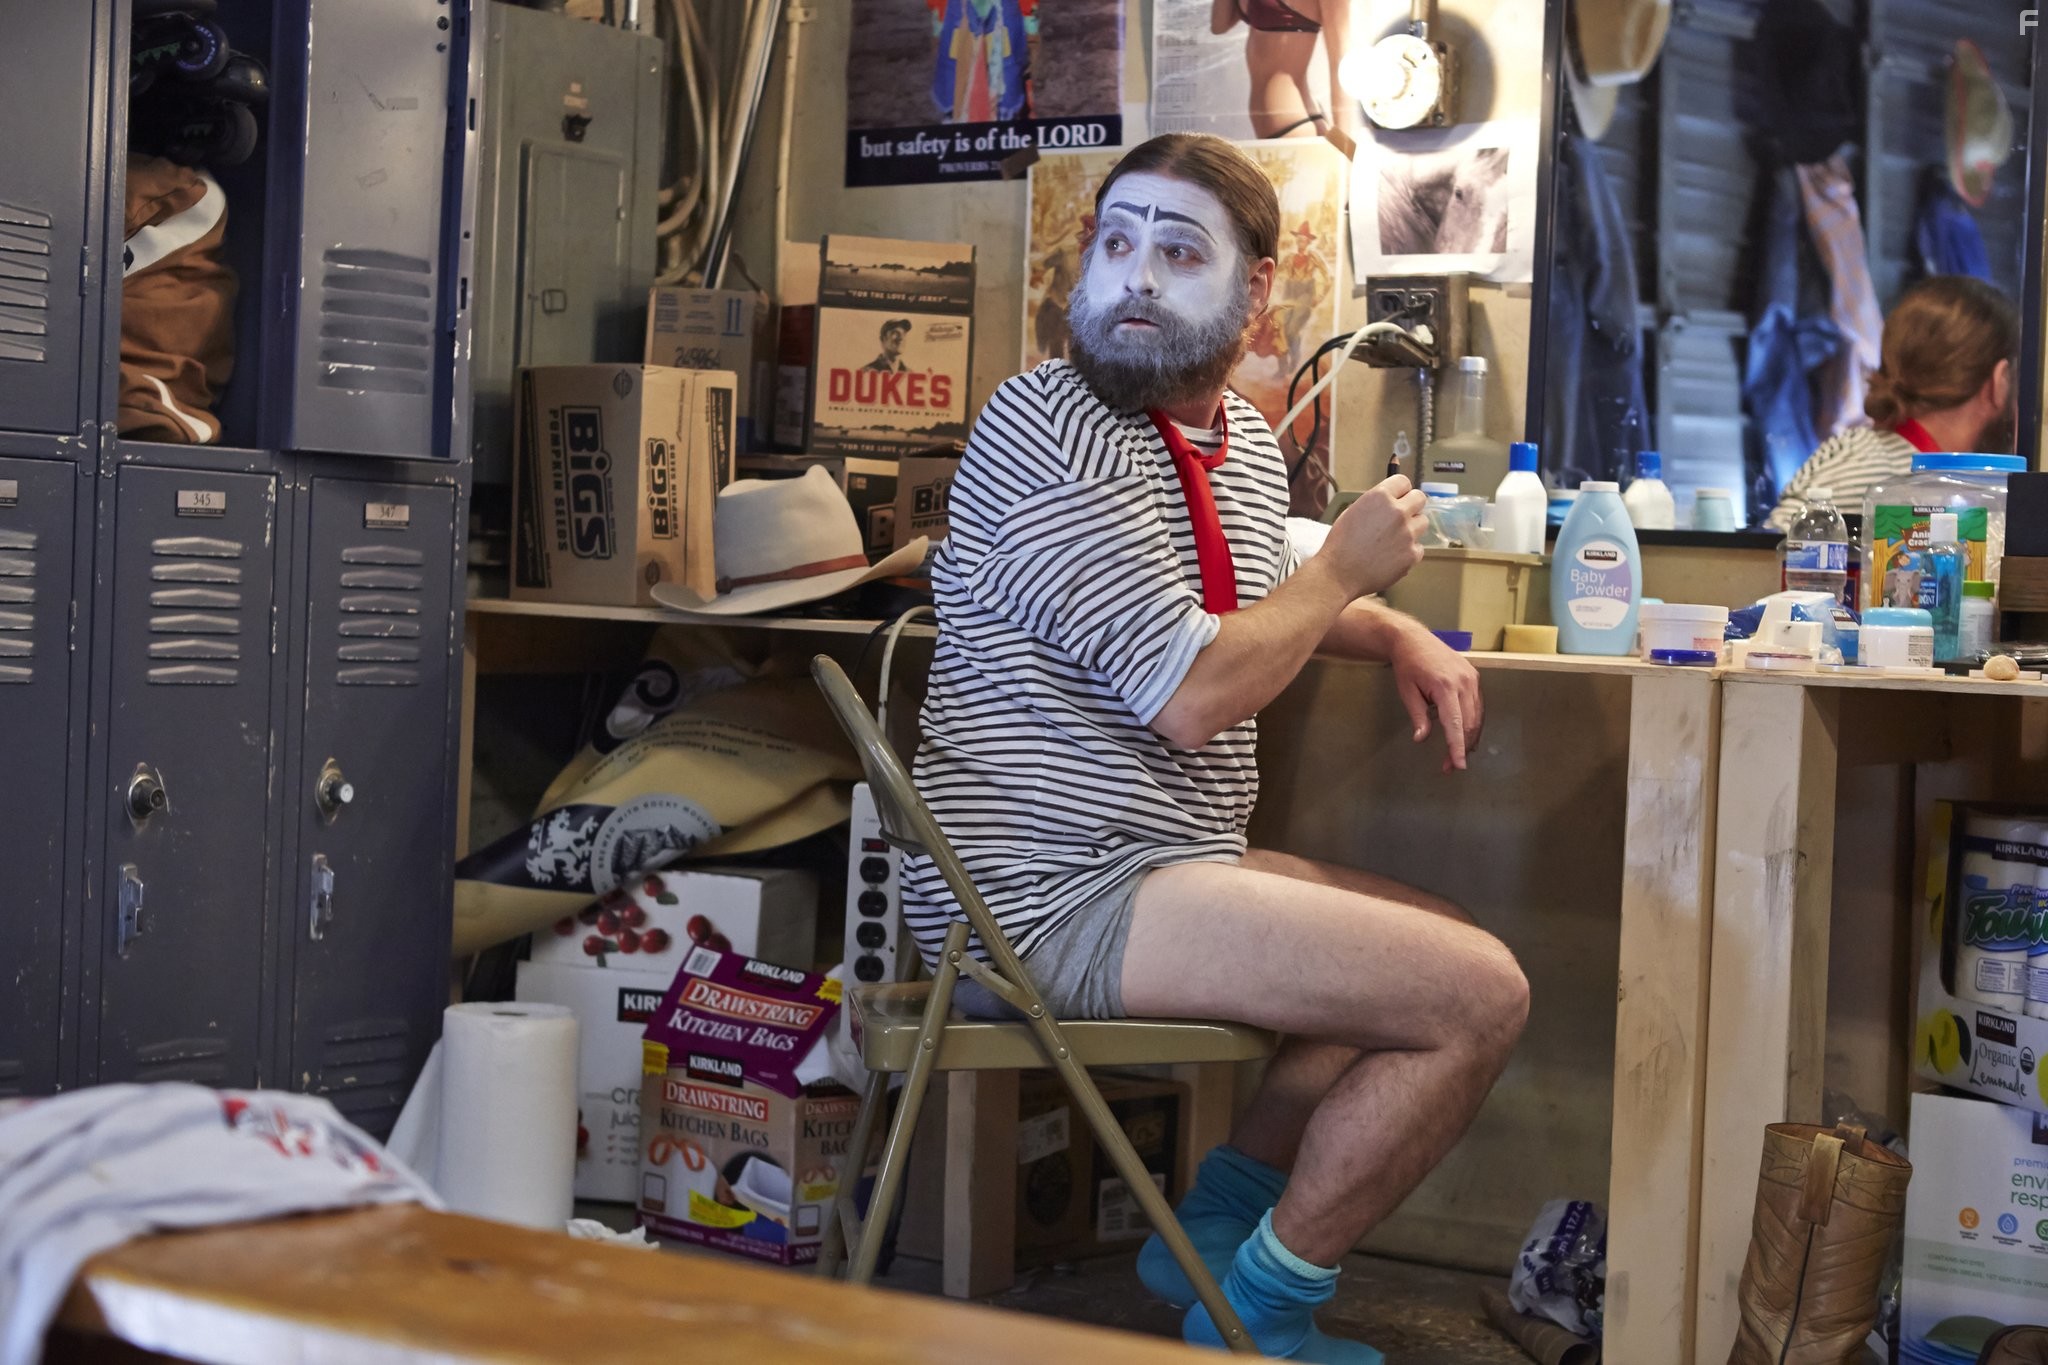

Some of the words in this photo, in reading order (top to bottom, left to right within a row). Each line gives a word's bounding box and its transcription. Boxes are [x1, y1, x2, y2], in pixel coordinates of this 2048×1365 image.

[860, 136, 892, 158] but
[897, 131, 950, 160] safety
[955, 128, 970, 151] is
[975, 127, 998, 150] of
[1000, 126, 1032, 149] the
[1037, 123, 1106, 148] LORD
[939, 160, 990, 174] PROVERBS
[828, 367, 952, 411] DUKE'S
[193, 492, 211, 506] 345
[554, 496, 568, 552] SEEDS
[1912, 530, 1931, 539] Ani
[1586, 550, 1617, 558] KIRKLAND
[1570, 568, 1606, 586] Baby
[1576, 582, 1629, 597] Powder
[643, 799, 679, 809] ROCKY
[744, 959, 805, 984] KIRKLAND
[688, 983, 813, 1025] DRAWSTRING
[667, 1008, 749, 1042] KITCHEN
[749, 1027, 799, 1050] BAGS
[1978, 1014, 2015, 1034] KIRKLAND
[689, 1055, 742, 1077] KIRKLAND
[1979, 1043, 2017, 1067] Organic
[1969, 1049, 2027, 1101] Lemonade
[666, 1082, 765, 1119] DRAWSTRING
[660, 1107, 727, 1139] KITCHEN
[731, 1122, 769, 1147] BAGS
